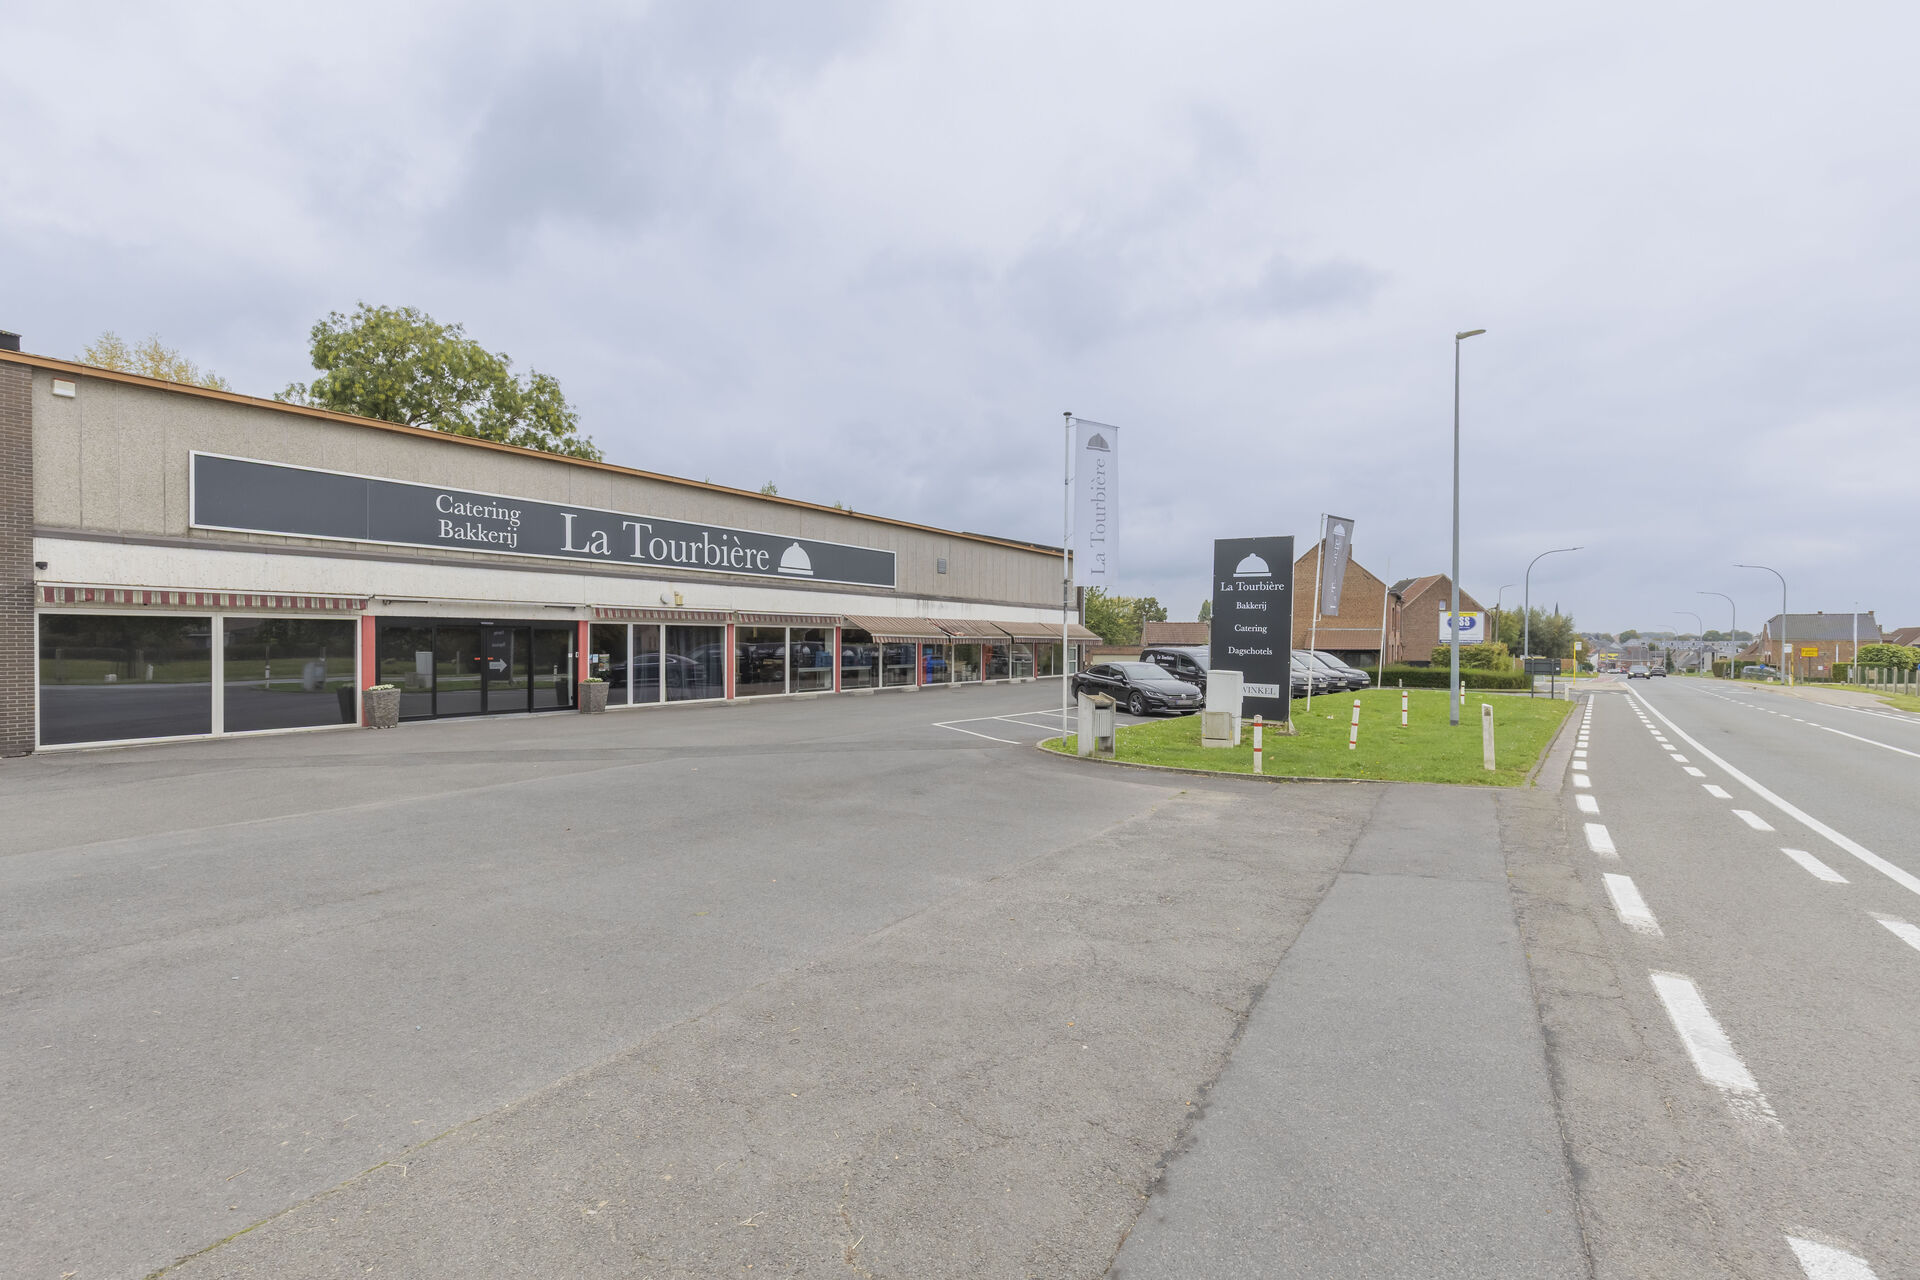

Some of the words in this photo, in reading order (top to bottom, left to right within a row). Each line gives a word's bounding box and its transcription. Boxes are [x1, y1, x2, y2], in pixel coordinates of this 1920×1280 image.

[435, 494, 522, 527] Catering
[1090, 458, 1106, 548] Tourbière
[438, 519, 518, 548] Bakkerij
[560, 513, 611, 556] La
[622, 521, 770, 571] Tourbière
[1090, 552, 1106, 576] La
[1220, 582, 1233, 592] La
[1236, 581, 1285, 591] Tourbière
[1236, 602, 1267, 611] Bakkerij
[1234, 624, 1268, 634] Catering
[1228, 647, 1273, 656] Dagschotels
